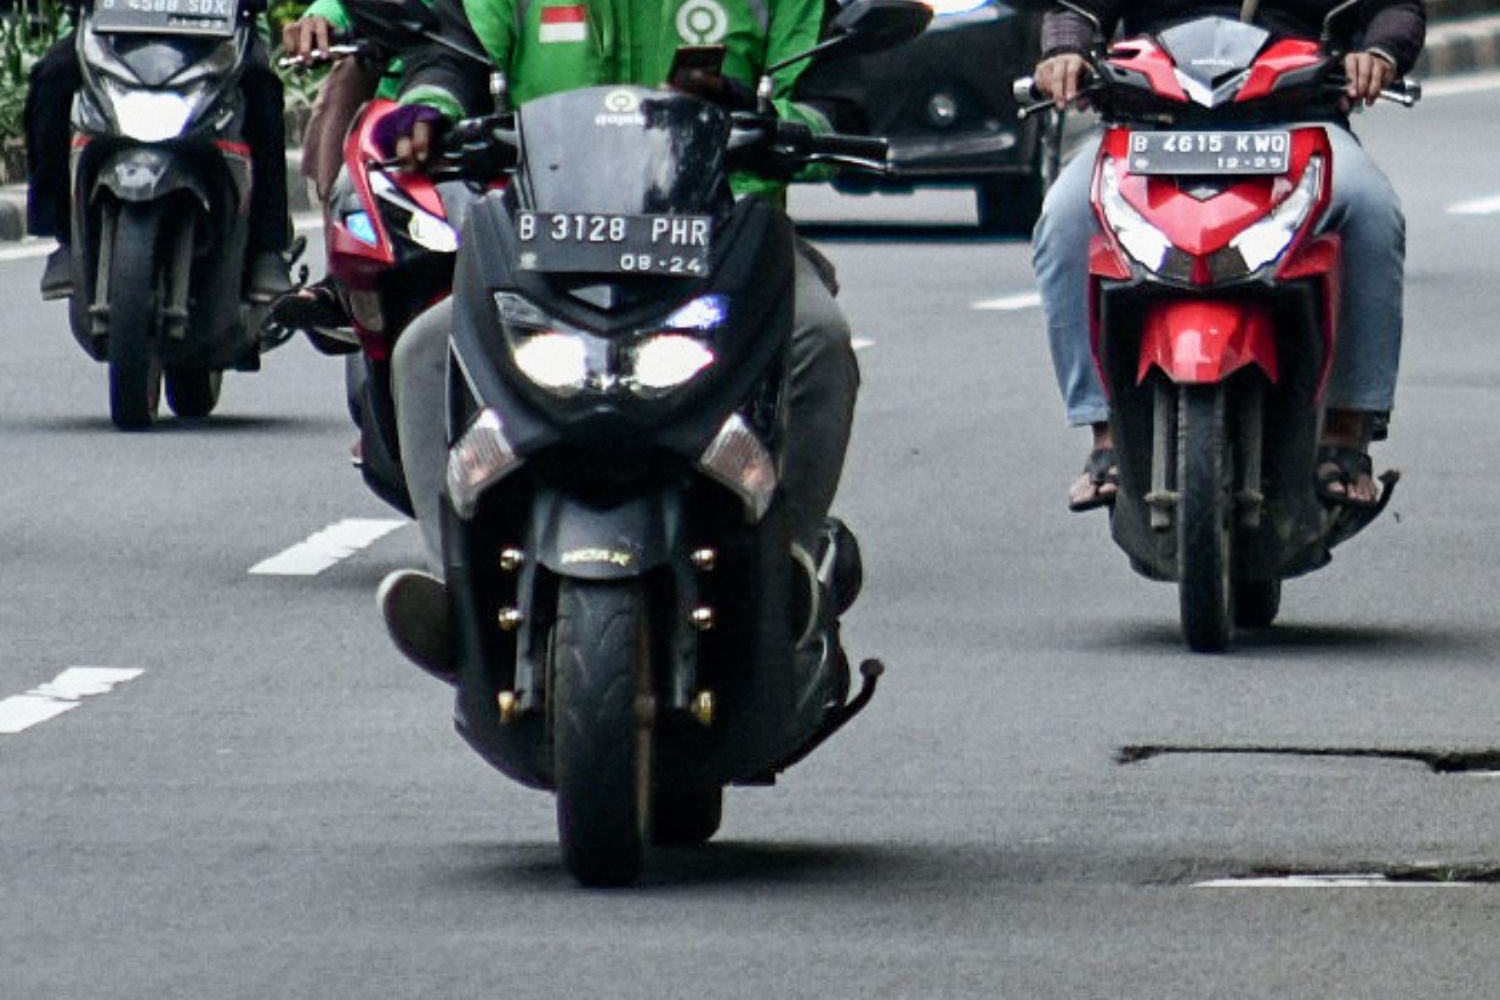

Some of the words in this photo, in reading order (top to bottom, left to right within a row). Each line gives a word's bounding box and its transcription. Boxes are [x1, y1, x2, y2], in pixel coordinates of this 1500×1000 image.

[1134, 136, 1148, 152] B
[1163, 135, 1223, 152] 4615
[519, 214, 535, 241] B
[551, 214, 625, 242] 3128
[652, 217, 707, 246] PHR
